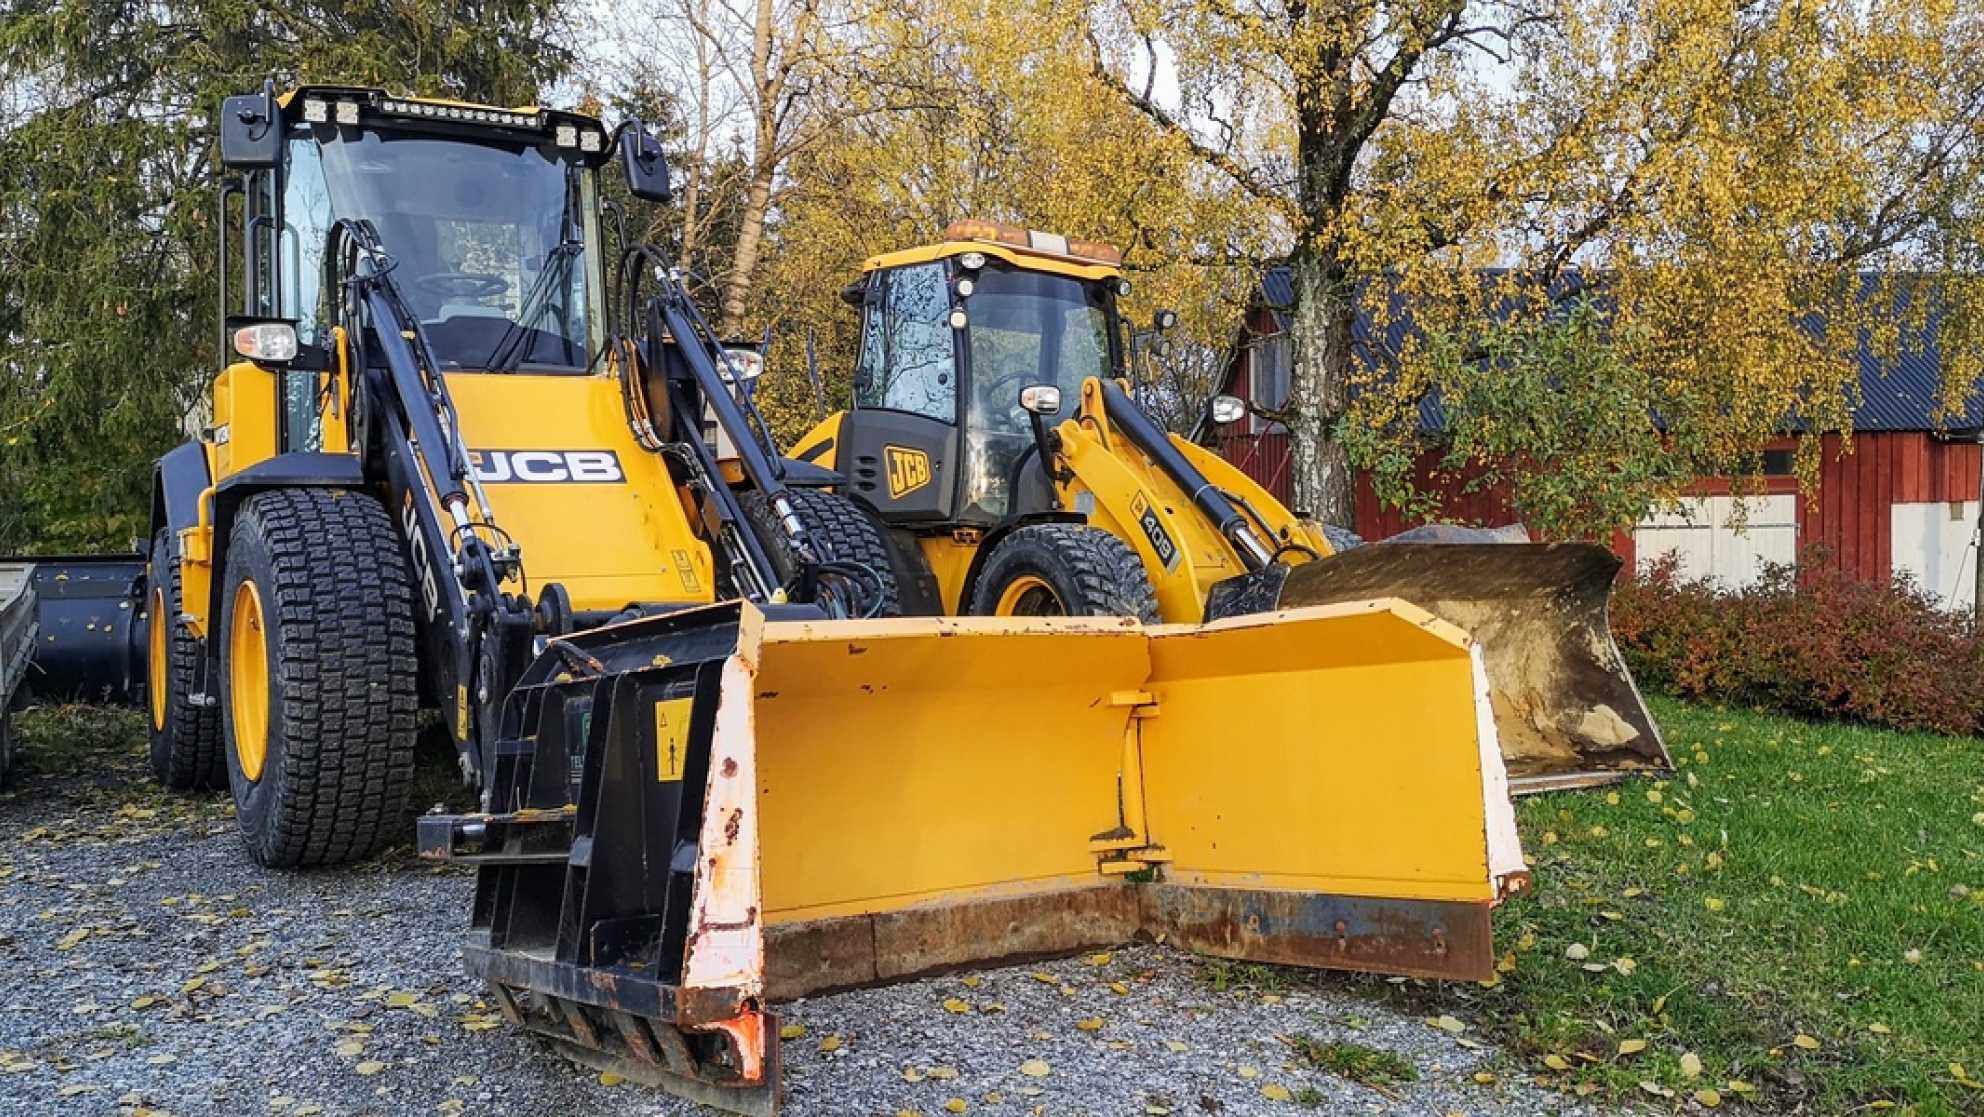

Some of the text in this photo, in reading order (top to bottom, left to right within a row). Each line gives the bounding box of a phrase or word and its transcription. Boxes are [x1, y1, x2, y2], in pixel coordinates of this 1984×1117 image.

[474, 451, 621, 481] JCB
[891, 451, 926, 493] JCB
[402, 504, 438, 623] JCB
